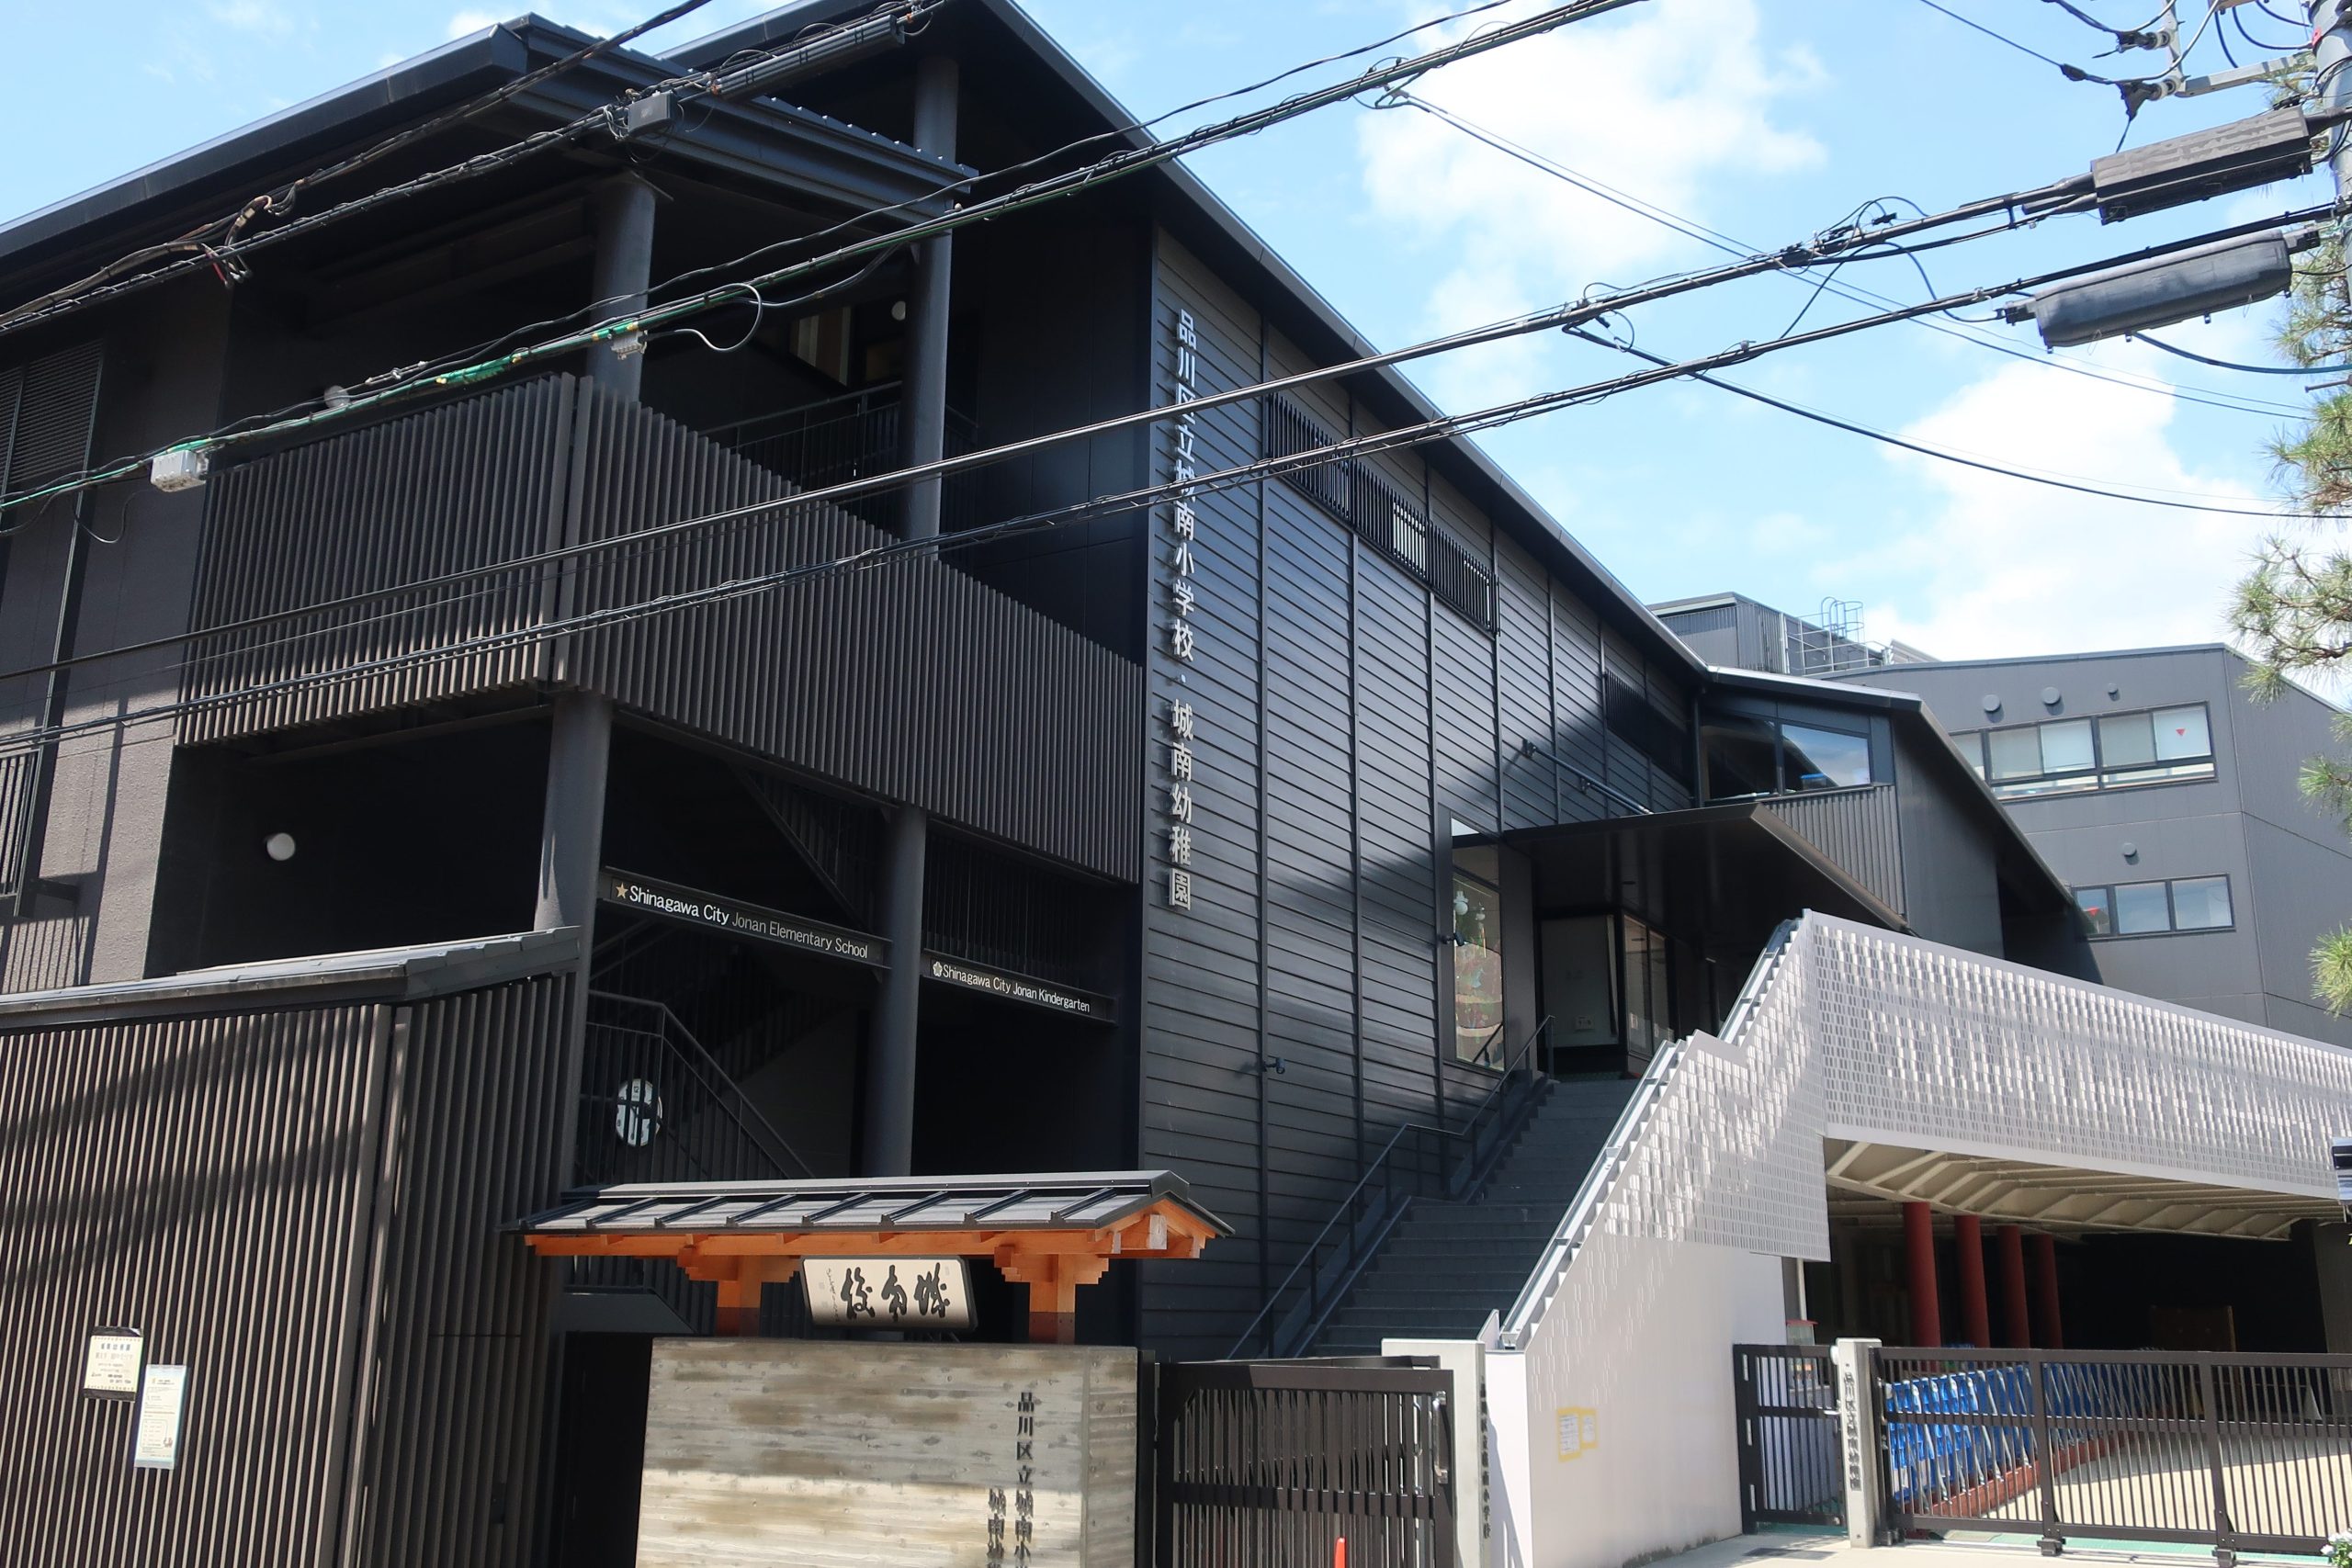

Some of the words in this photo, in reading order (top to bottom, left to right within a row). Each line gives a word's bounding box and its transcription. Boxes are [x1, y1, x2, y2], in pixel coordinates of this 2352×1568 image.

[629, 886, 699, 917] Shinagawa
[703, 904, 729, 925] City
[732, 912, 766, 933] Jonan
[770, 921, 832, 951] Elementary
[835, 938, 868, 959] School
[943, 964, 990, 987] Shinagawa
[993, 976, 1011, 994] City
[1013, 983, 1037, 999] Jonan
[1038, 988, 1091, 1013] Kindergarten
